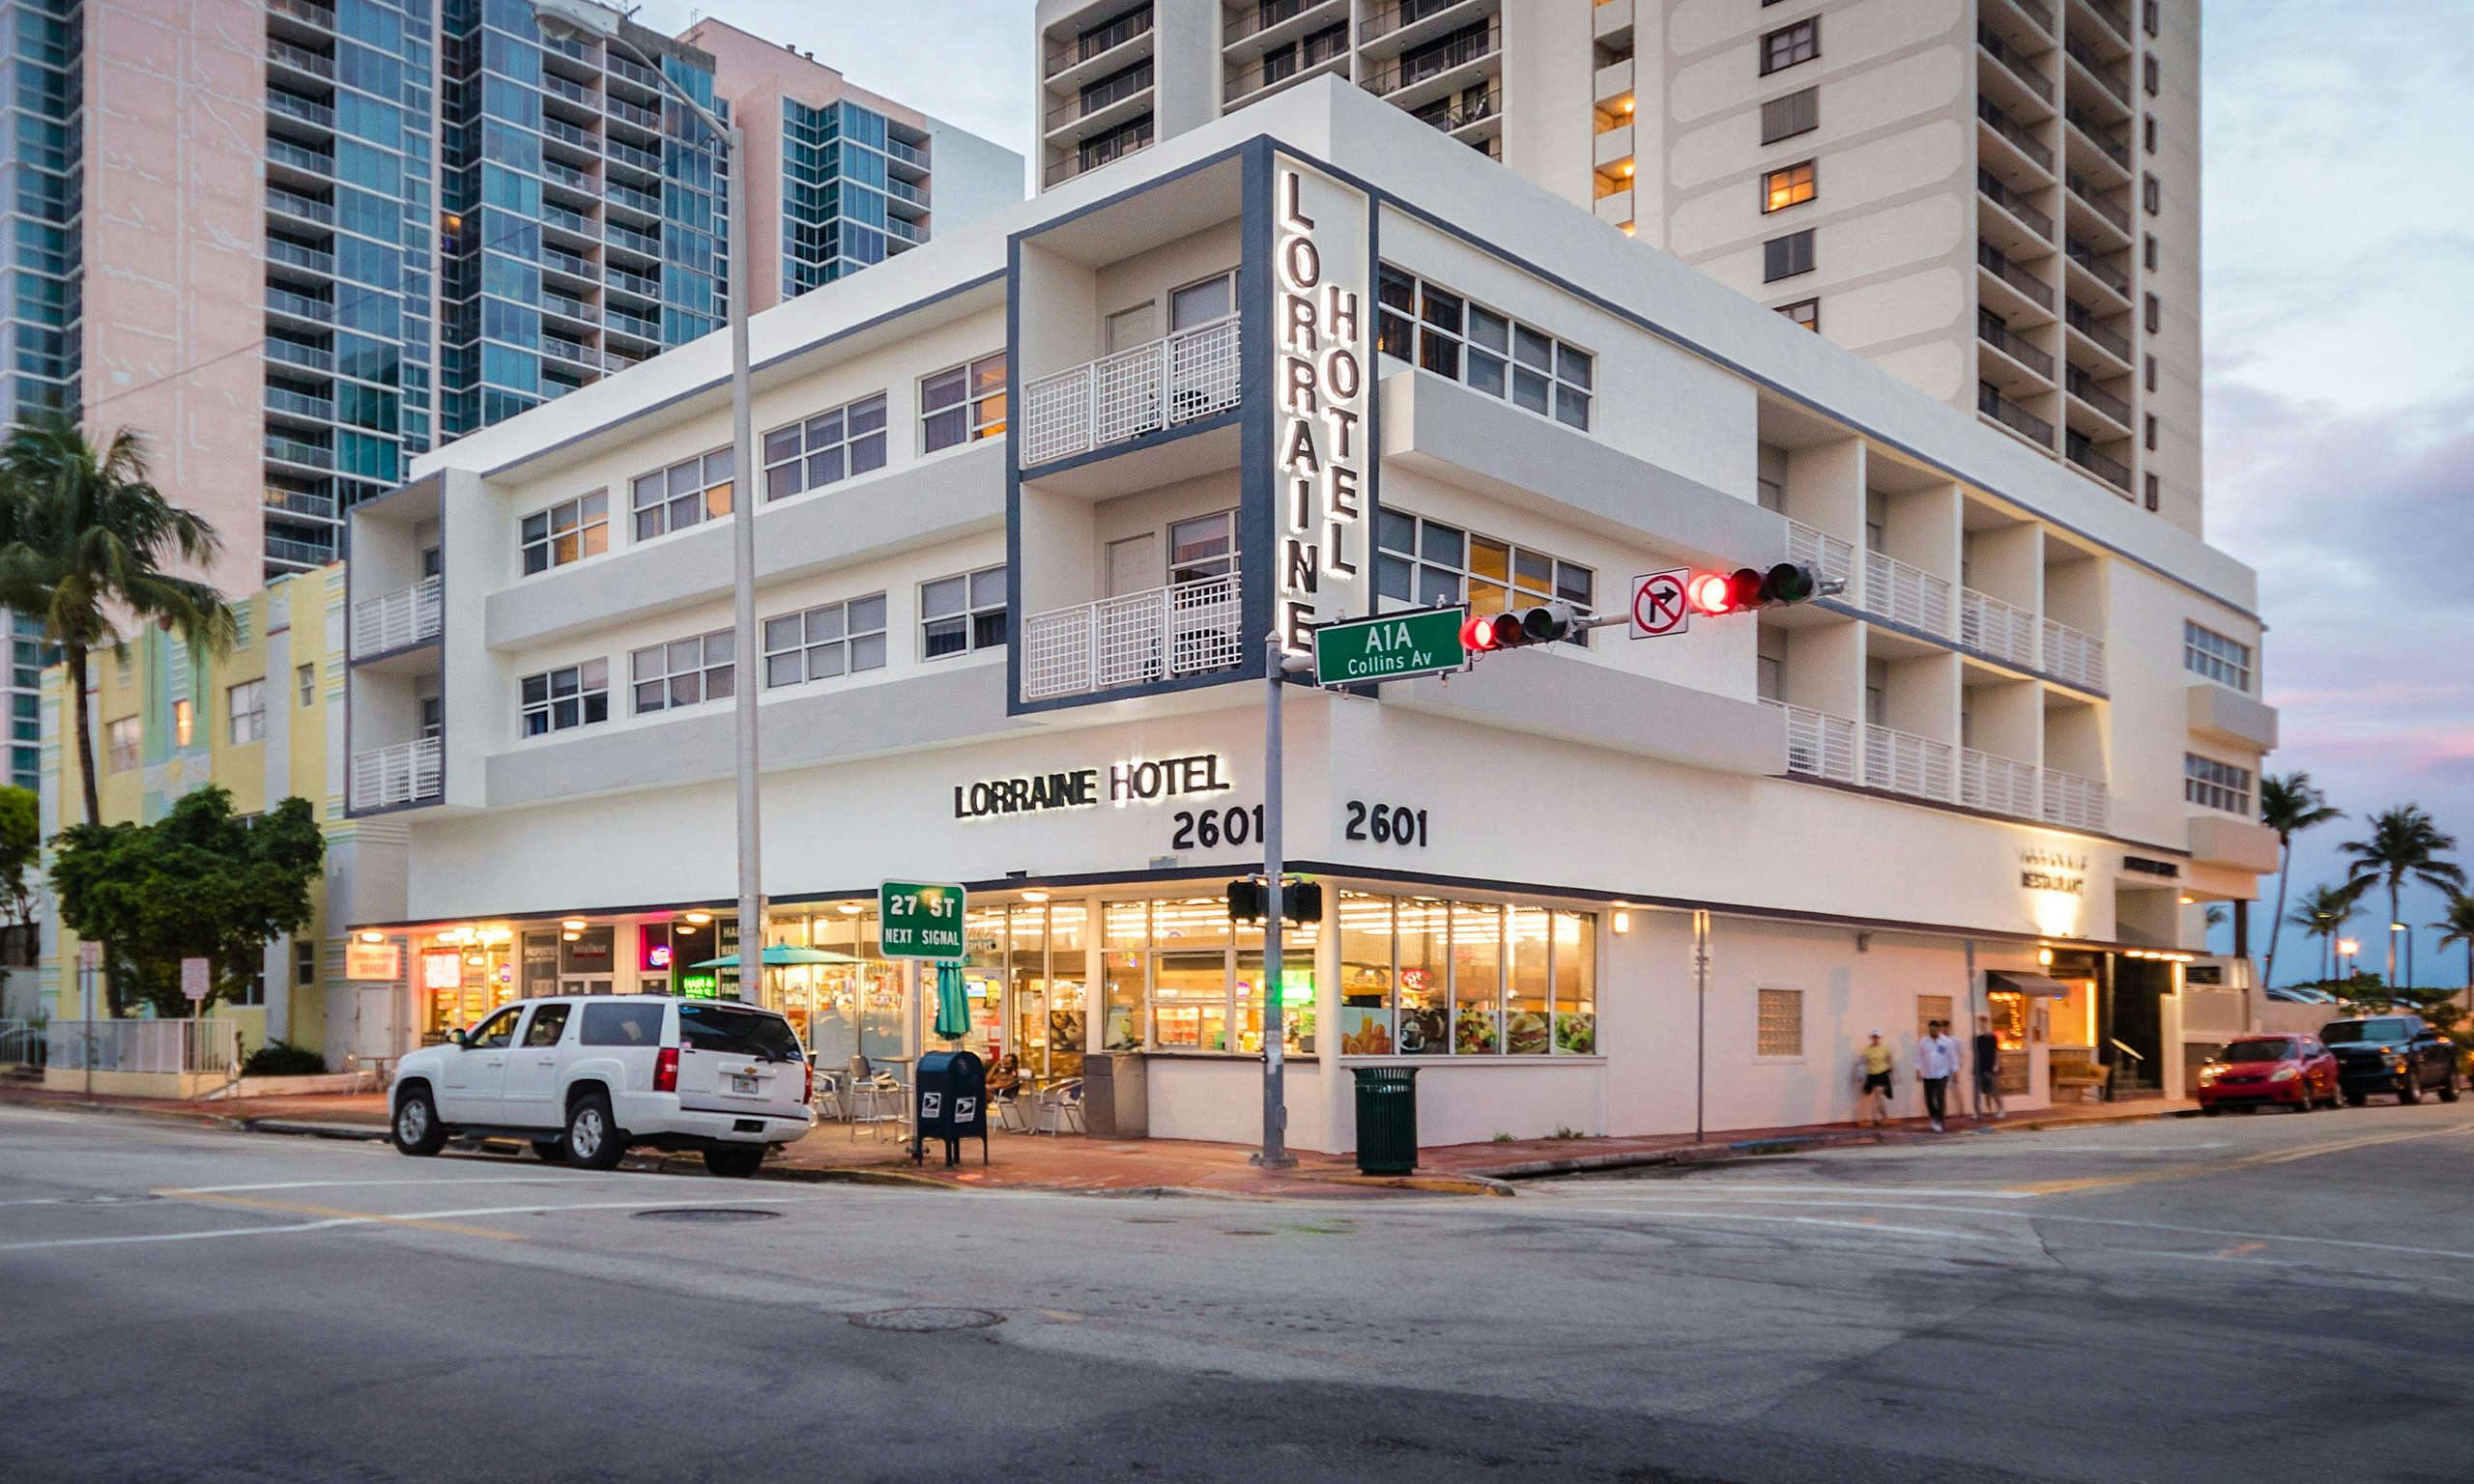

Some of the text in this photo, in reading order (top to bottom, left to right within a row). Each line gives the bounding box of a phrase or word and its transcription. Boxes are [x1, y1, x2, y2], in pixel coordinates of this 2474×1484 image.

[1286, 172, 1320, 654] LORRAINE
[1328, 285, 1360, 576] HOTEL
[1365, 621, 1413, 654] A1A
[1348, 650, 1432, 675] Collins Av
[955, 754, 1230, 818] LORRAINE HOTEL
[1172, 804, 1264, 850] 2601
[1345, 800, 1427, 847] 2601
[890, 895, 956, 919] 27 ST
[884, 928, 913, 944] NEXT
[921, 928, 960, 946] SIGNAL
